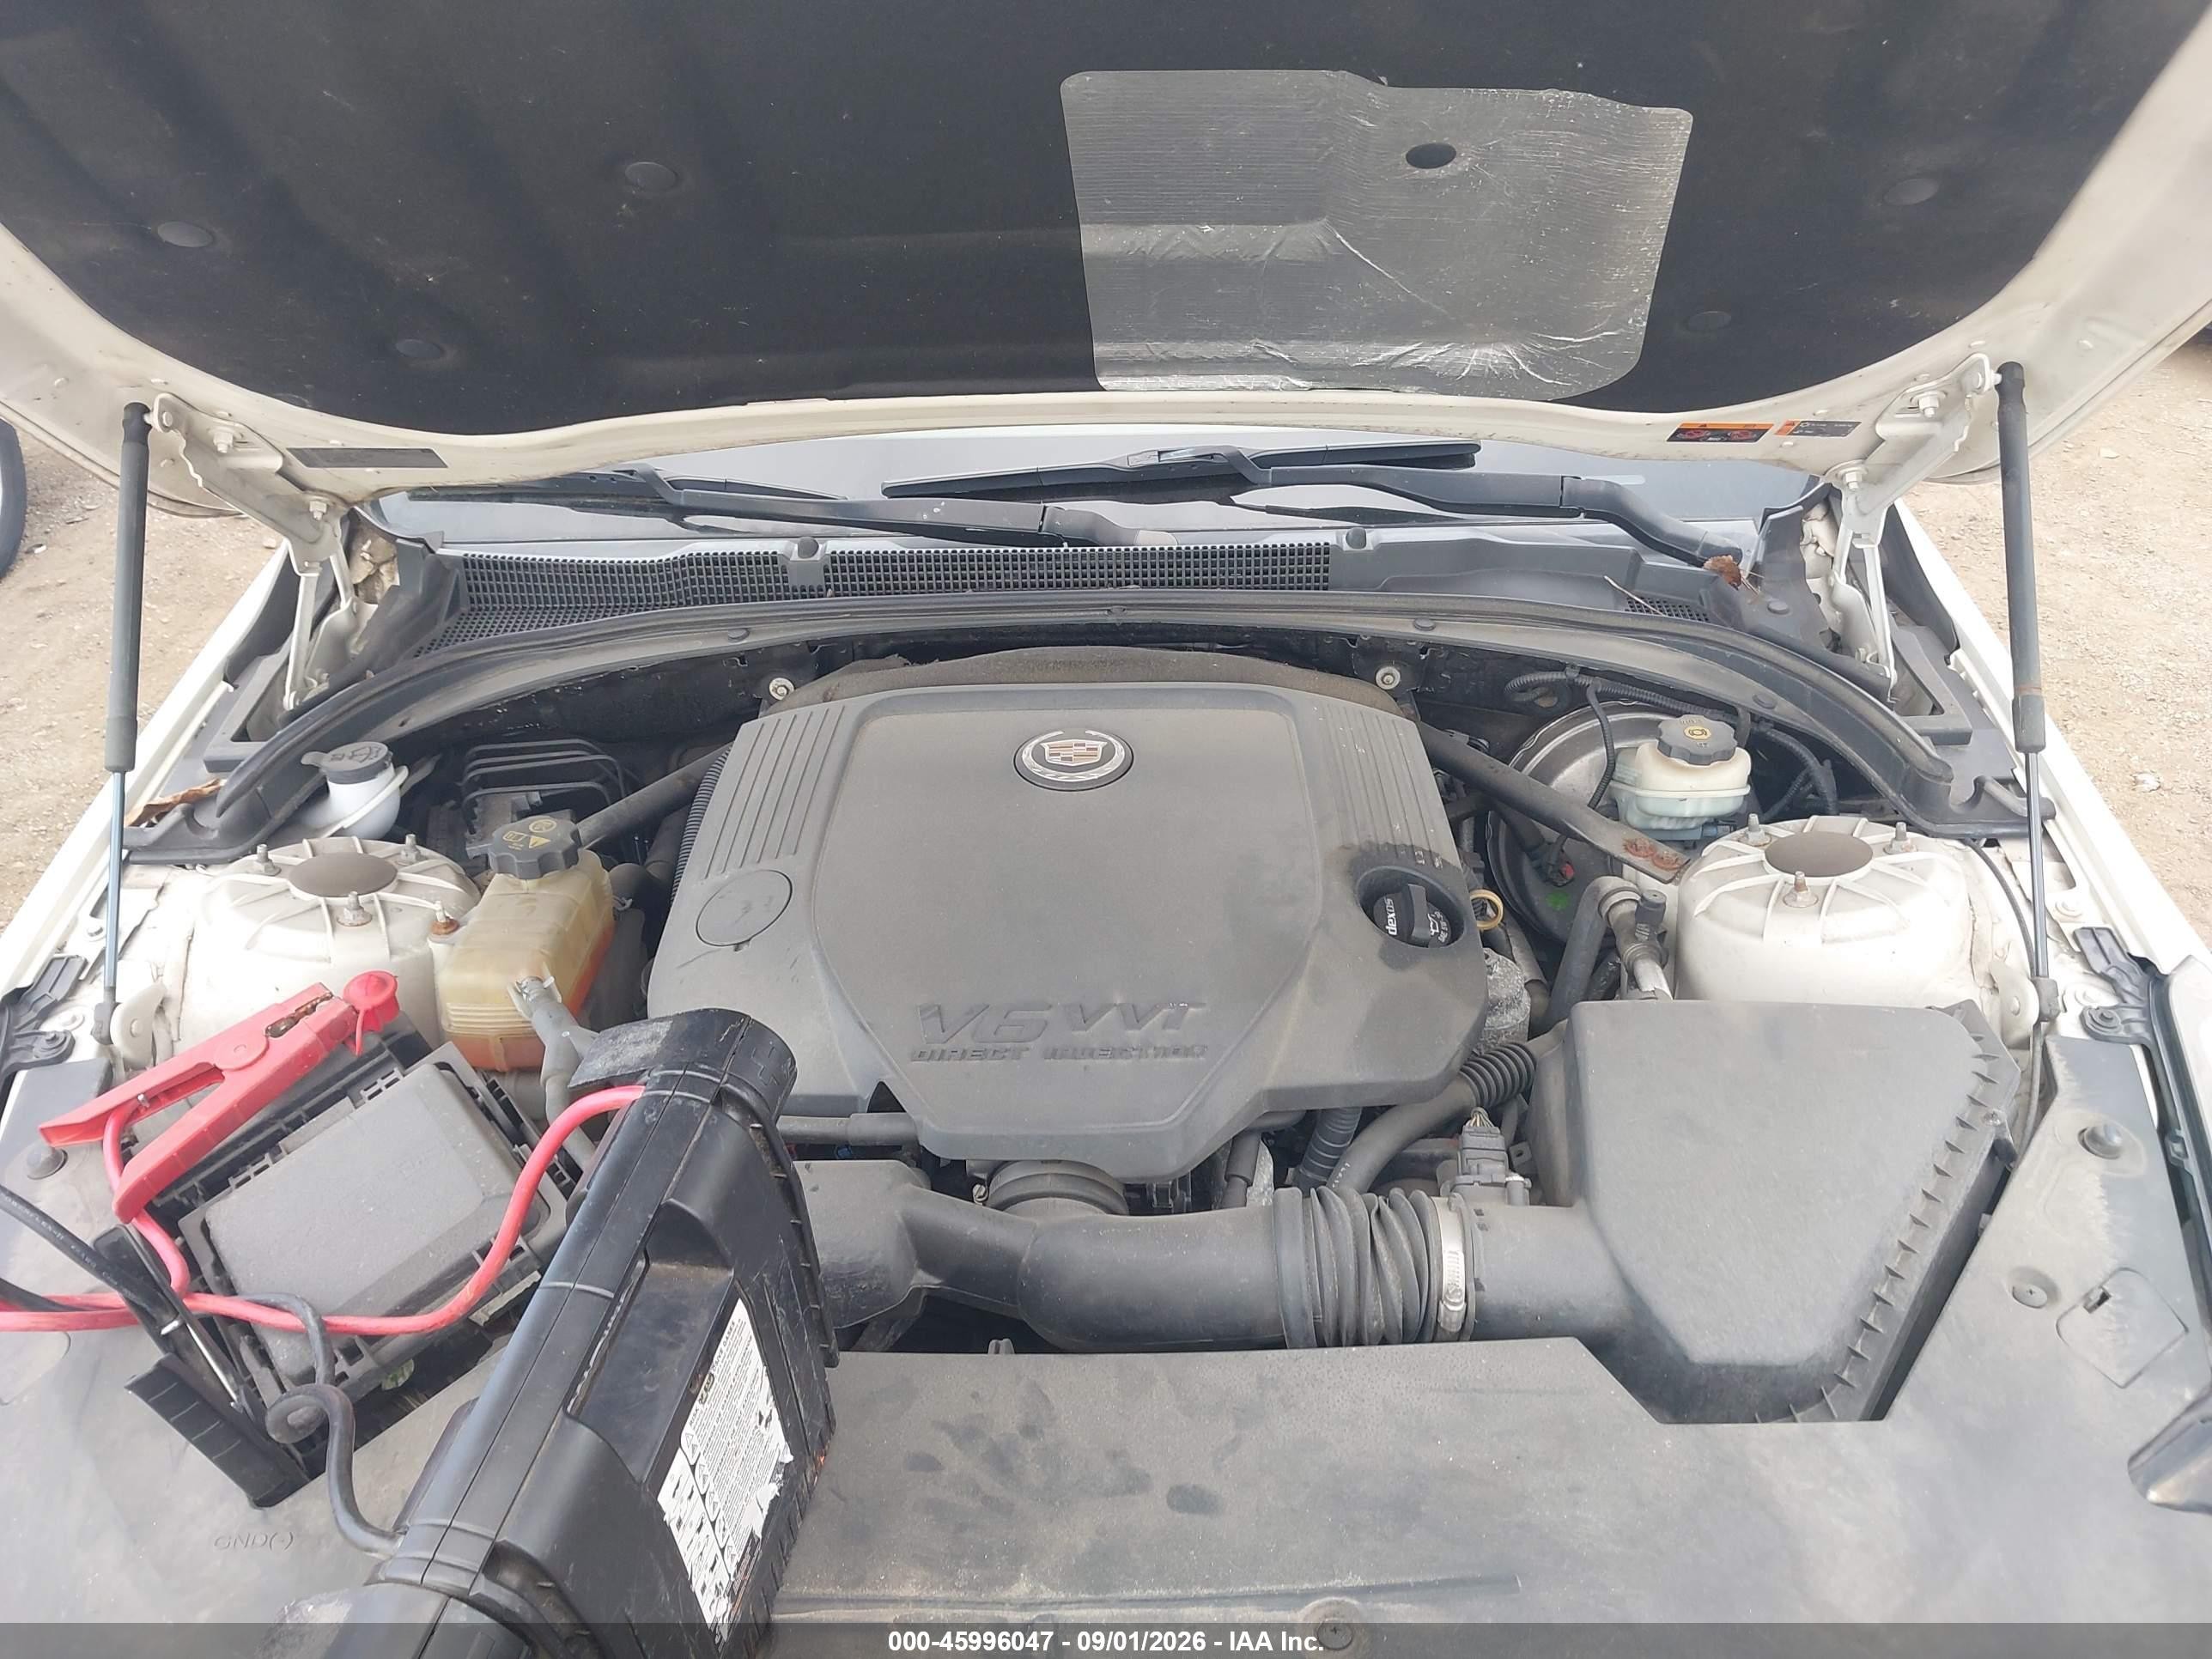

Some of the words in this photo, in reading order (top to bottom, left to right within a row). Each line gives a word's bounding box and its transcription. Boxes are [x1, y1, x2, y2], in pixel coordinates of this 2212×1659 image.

[1385, 898, 1397, 935] dexos
[917, 1003, 1053, 1044] V6
[1063, 1001, 1206, 1031] VVT
[908, 1046, 1031, 1061] DIRECT
[1041, 1043, 1208, 1060] INJECTION
[689, 1404, 700, 1427] RISK
